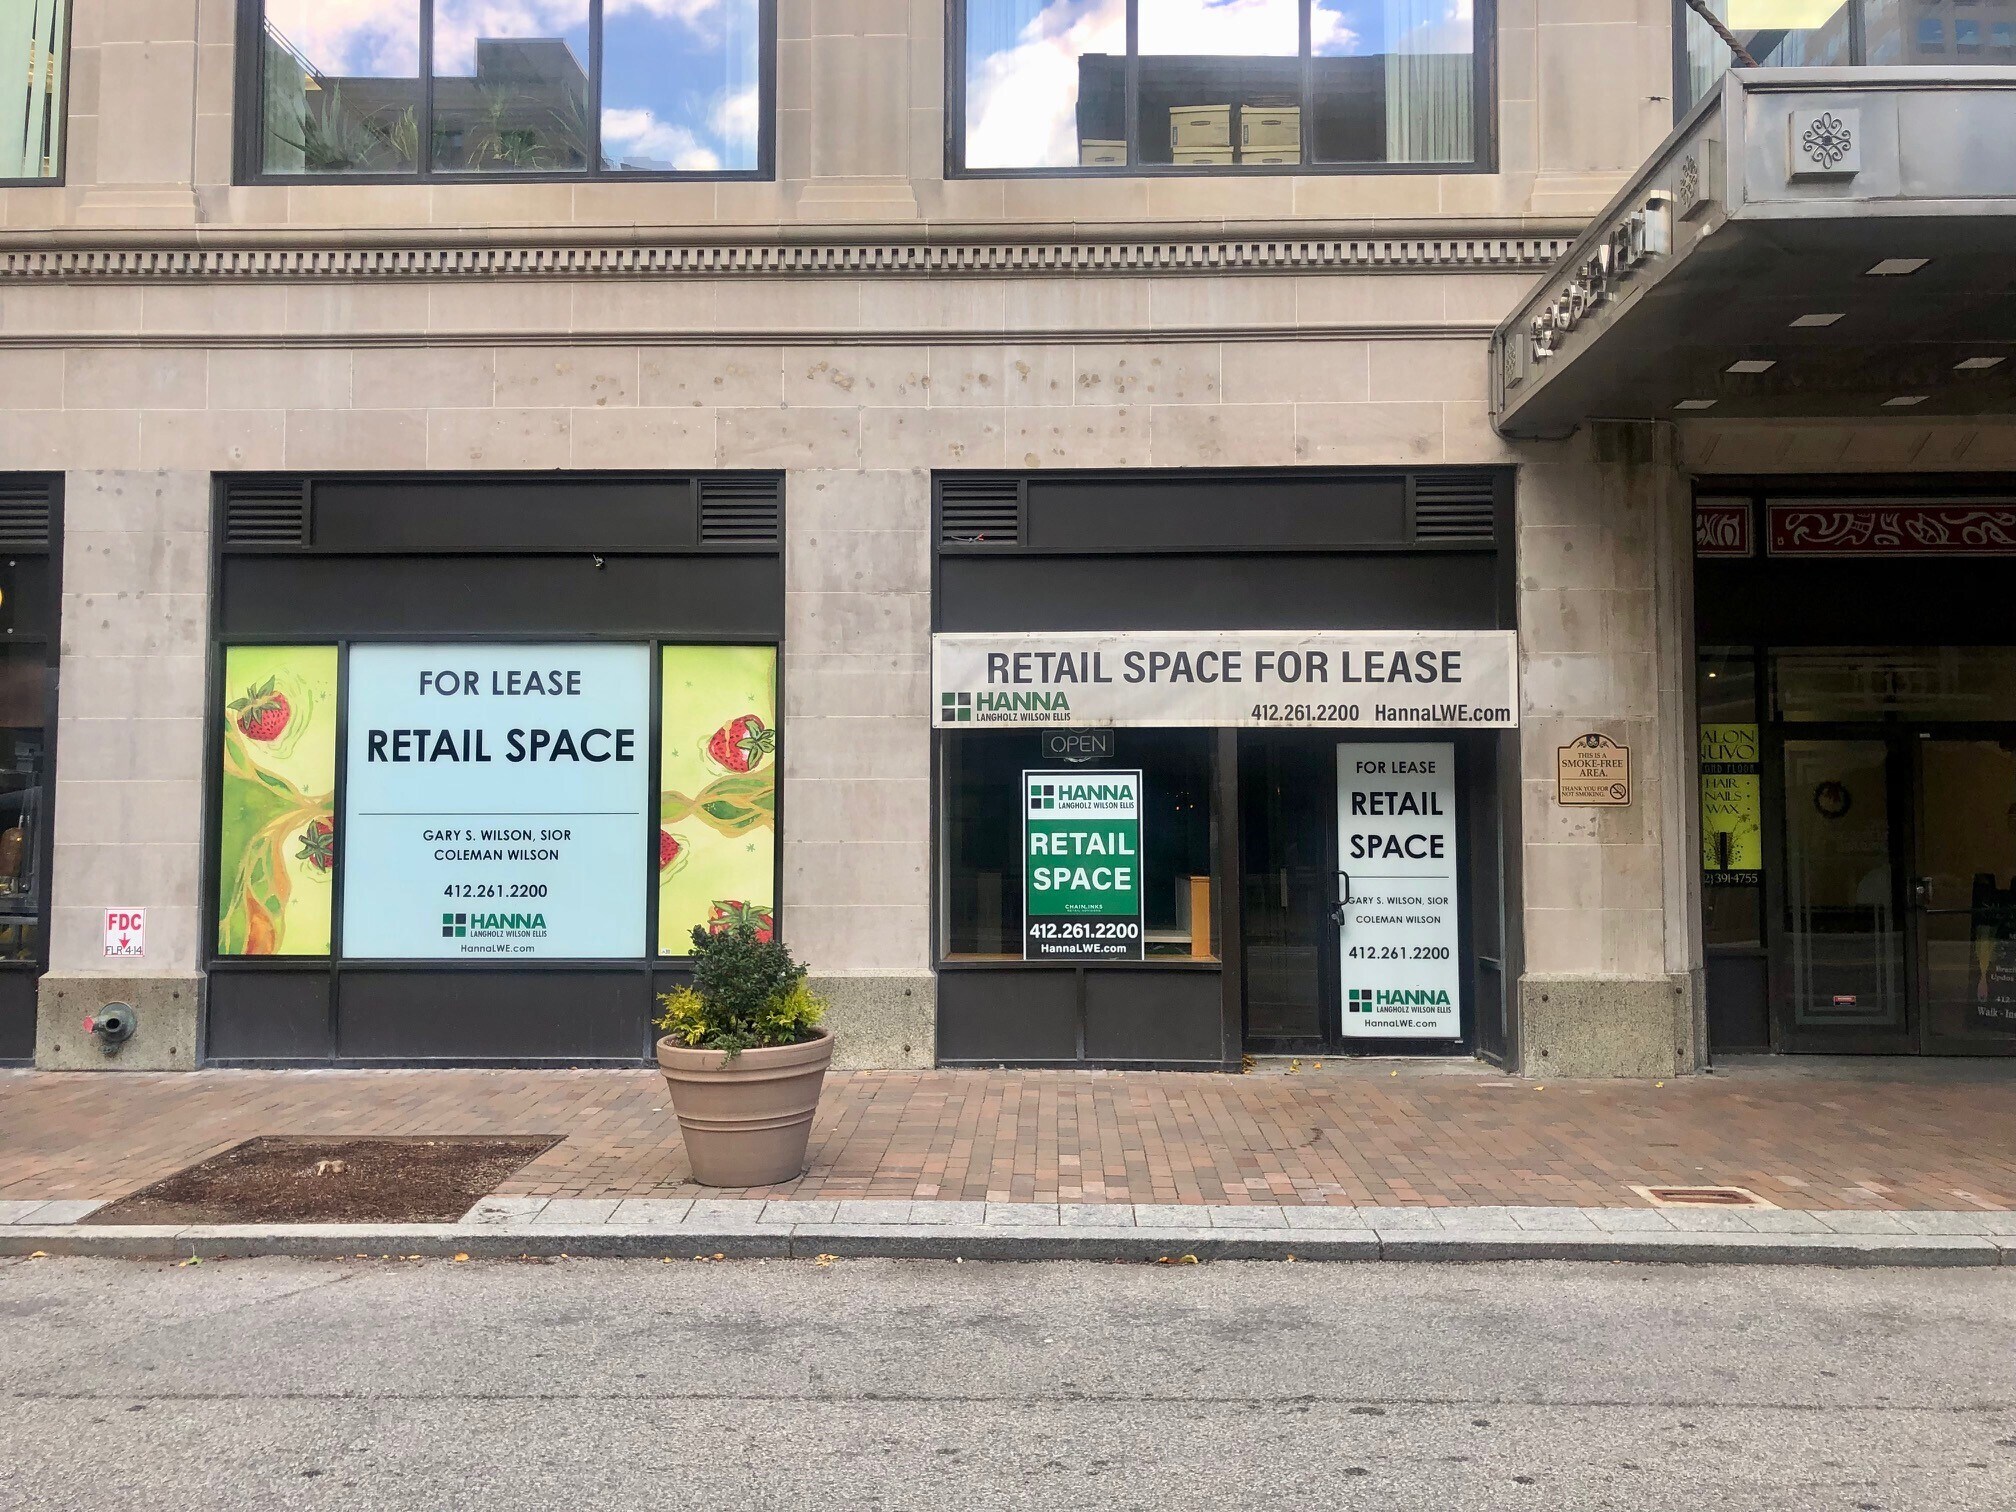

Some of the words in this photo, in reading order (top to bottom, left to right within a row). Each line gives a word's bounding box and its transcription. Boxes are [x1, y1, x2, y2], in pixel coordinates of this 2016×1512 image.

[987, 651, 1113, 684] RETAIL
[1122, 650, 1242, 683] SPACE
[1255, 650, 1328, 683] FOR
[1342, 650, 1462, 683] LEASE
[419, 670, 480, 696] FOR
[492, 670, 581, 696] LEASE
[976, 691, 1070, 711] HANNA
[976, 712, 1018, 722] LANGHOLZ
[1020, 712, 1051, 722] WILSON
[1053, 712, 1071, 722] ELLIS
[1251, 704, 1360, 722] 412.261.2200
[1375, 704, 1511, 722] HannaLWE.com
[1701, 729, 1754, 743] ALON
[368, 729, 491, 762] RETAIL
[505, 728, 635, 763] SPACE
[1050, 735, 1106, 753] OPEN
[1356, 761, 1386, 774] FOR
[1391, 761, 1436, 774] LEASE
[1561, 759, 1623, 768] SMOKE-FREE
[1579, 768, 1608, 777] AREA.
[1705, 778, 1739, 788] HAIR
[1058, 784, 1134, 801] HANNA
[1704, 791, 1743, 801] NAILS
[1058, 801, 1092, 810] LANGHOLZ
[1093, 801, 1118, 810] WILSON
[1119, 801, 1135, 809] ELLIS
[1351, 791, 1443, 816] RETAIL
[1705, 804, 1740, 814] WAX
[423, 829, 461, 841] GARY
[465, 829, 476, 841] S.
[481, 829, 536, 843] WILSON,
[540, 829, 571, 841] SIOR
[1030, 832, 1135, 856] RETAIL
[1350, 834, 1444, 859] SPACE
[434, 849, 503, 861] COLEMAN
[507, 849, 559, 861] WILSON
[1033, 867, 1131, 891] SPACE
[444, 884, 548, 898] 412.261.2200
[1348, 896, 1373, 905] GARY
[1376, 896, 1384, 905] S.
[1386, 896, 1425, 906] WILSON,
[1427, 896, 1449, 905] SIOR
[108, 913, 142, 931] FDC
[470, 913, 547, 929] HANNA
[1355, 915, 1403, 924] COLEMAN
[1405, 915, 1441, 924] WILSON
[470, 930, 504, 938] LANGHOLZ
[505, 930, 531, 938] WILSON
[532, 930, 547, 938] ELLIS
[1029, 923, 1139, 939] 412.261.2200
[105, 945, 123, 955] FLR
[125, 945, 142, 955] 4-14
[460, 944, 535, 953] HannaLWE.com
[1041, 943, 1127, 953] HannaLWE.com
[1348, 946, 1450, 960] 412.261.2200
[1376, 989, 1451, 1005] HANNA
[1376, 1006, 1410, 1014] LANGHOLZ
[1411, 1006, 1436, 1014] WILSON
[1437, 1006, 1452, 1014] ELLIS
[1977, 1005, 1998, 1017] Walk
[1364, 1019, 1437, 1028] HannaLWE.com
